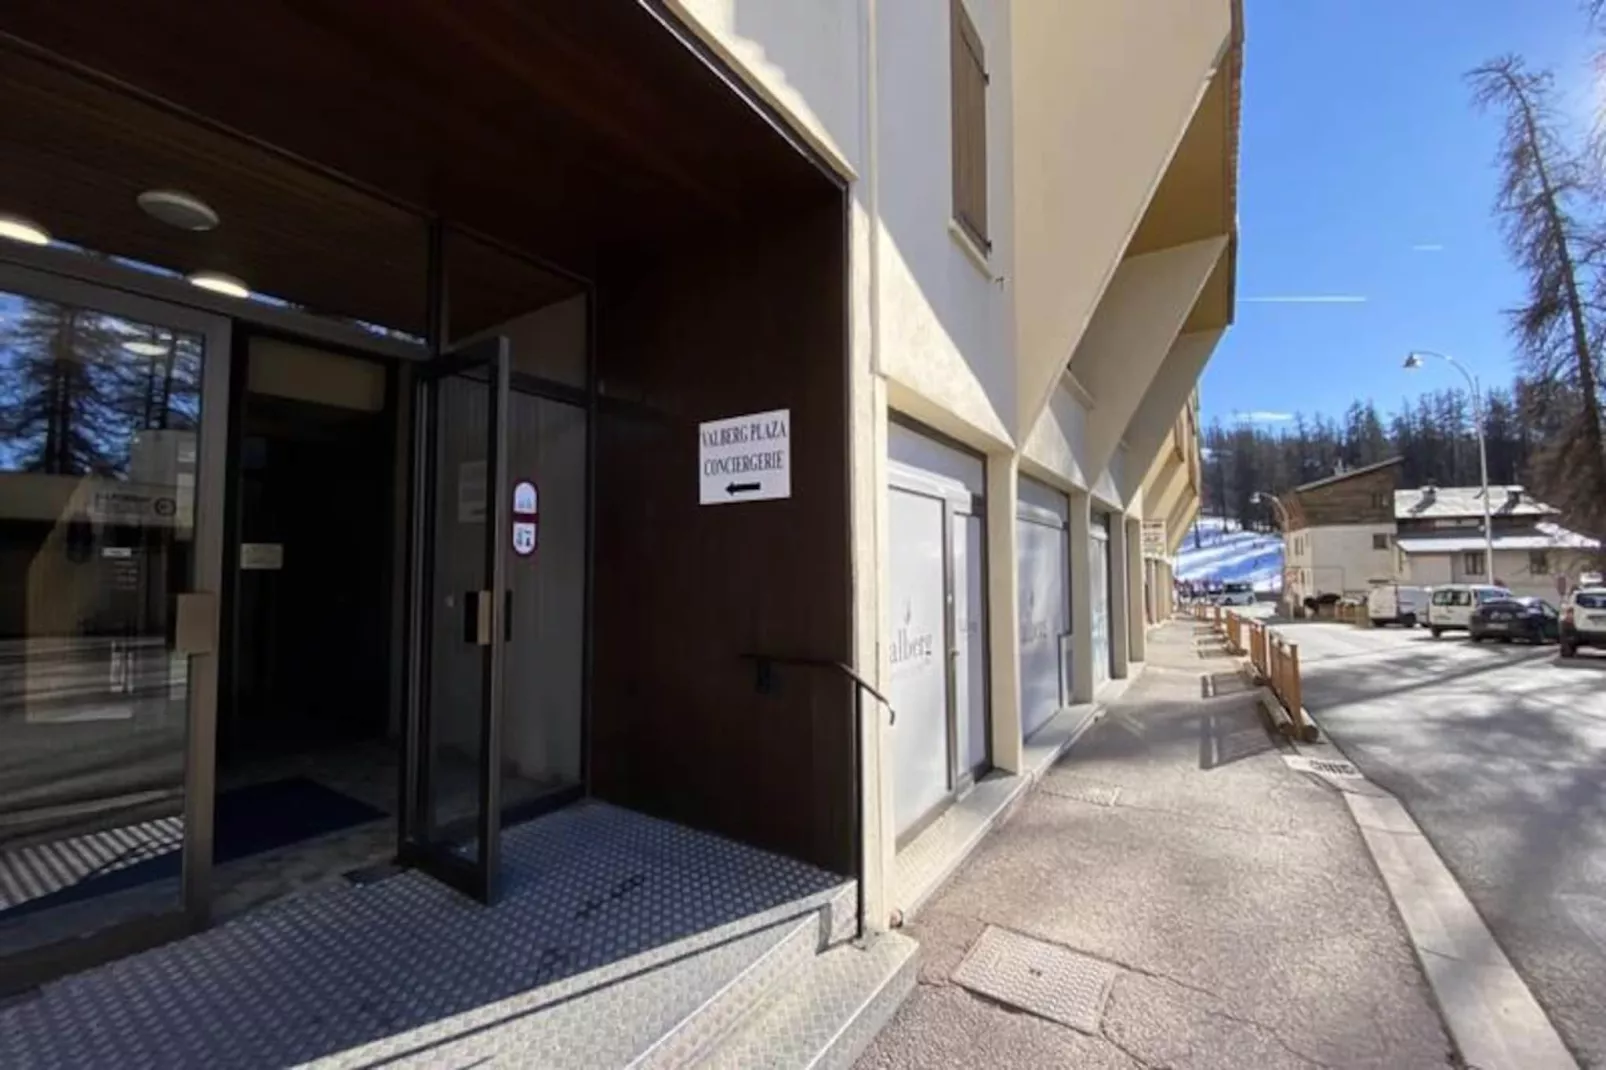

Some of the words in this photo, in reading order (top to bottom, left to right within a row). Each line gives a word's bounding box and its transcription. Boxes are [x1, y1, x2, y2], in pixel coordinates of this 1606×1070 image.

[702, 424, 748, 448] VALBERG
[750, 420, 787, 441] PLAZA
[703, 450, 785, 476] CONCIERGERIE
[889, 628, 932, 665] alberg
